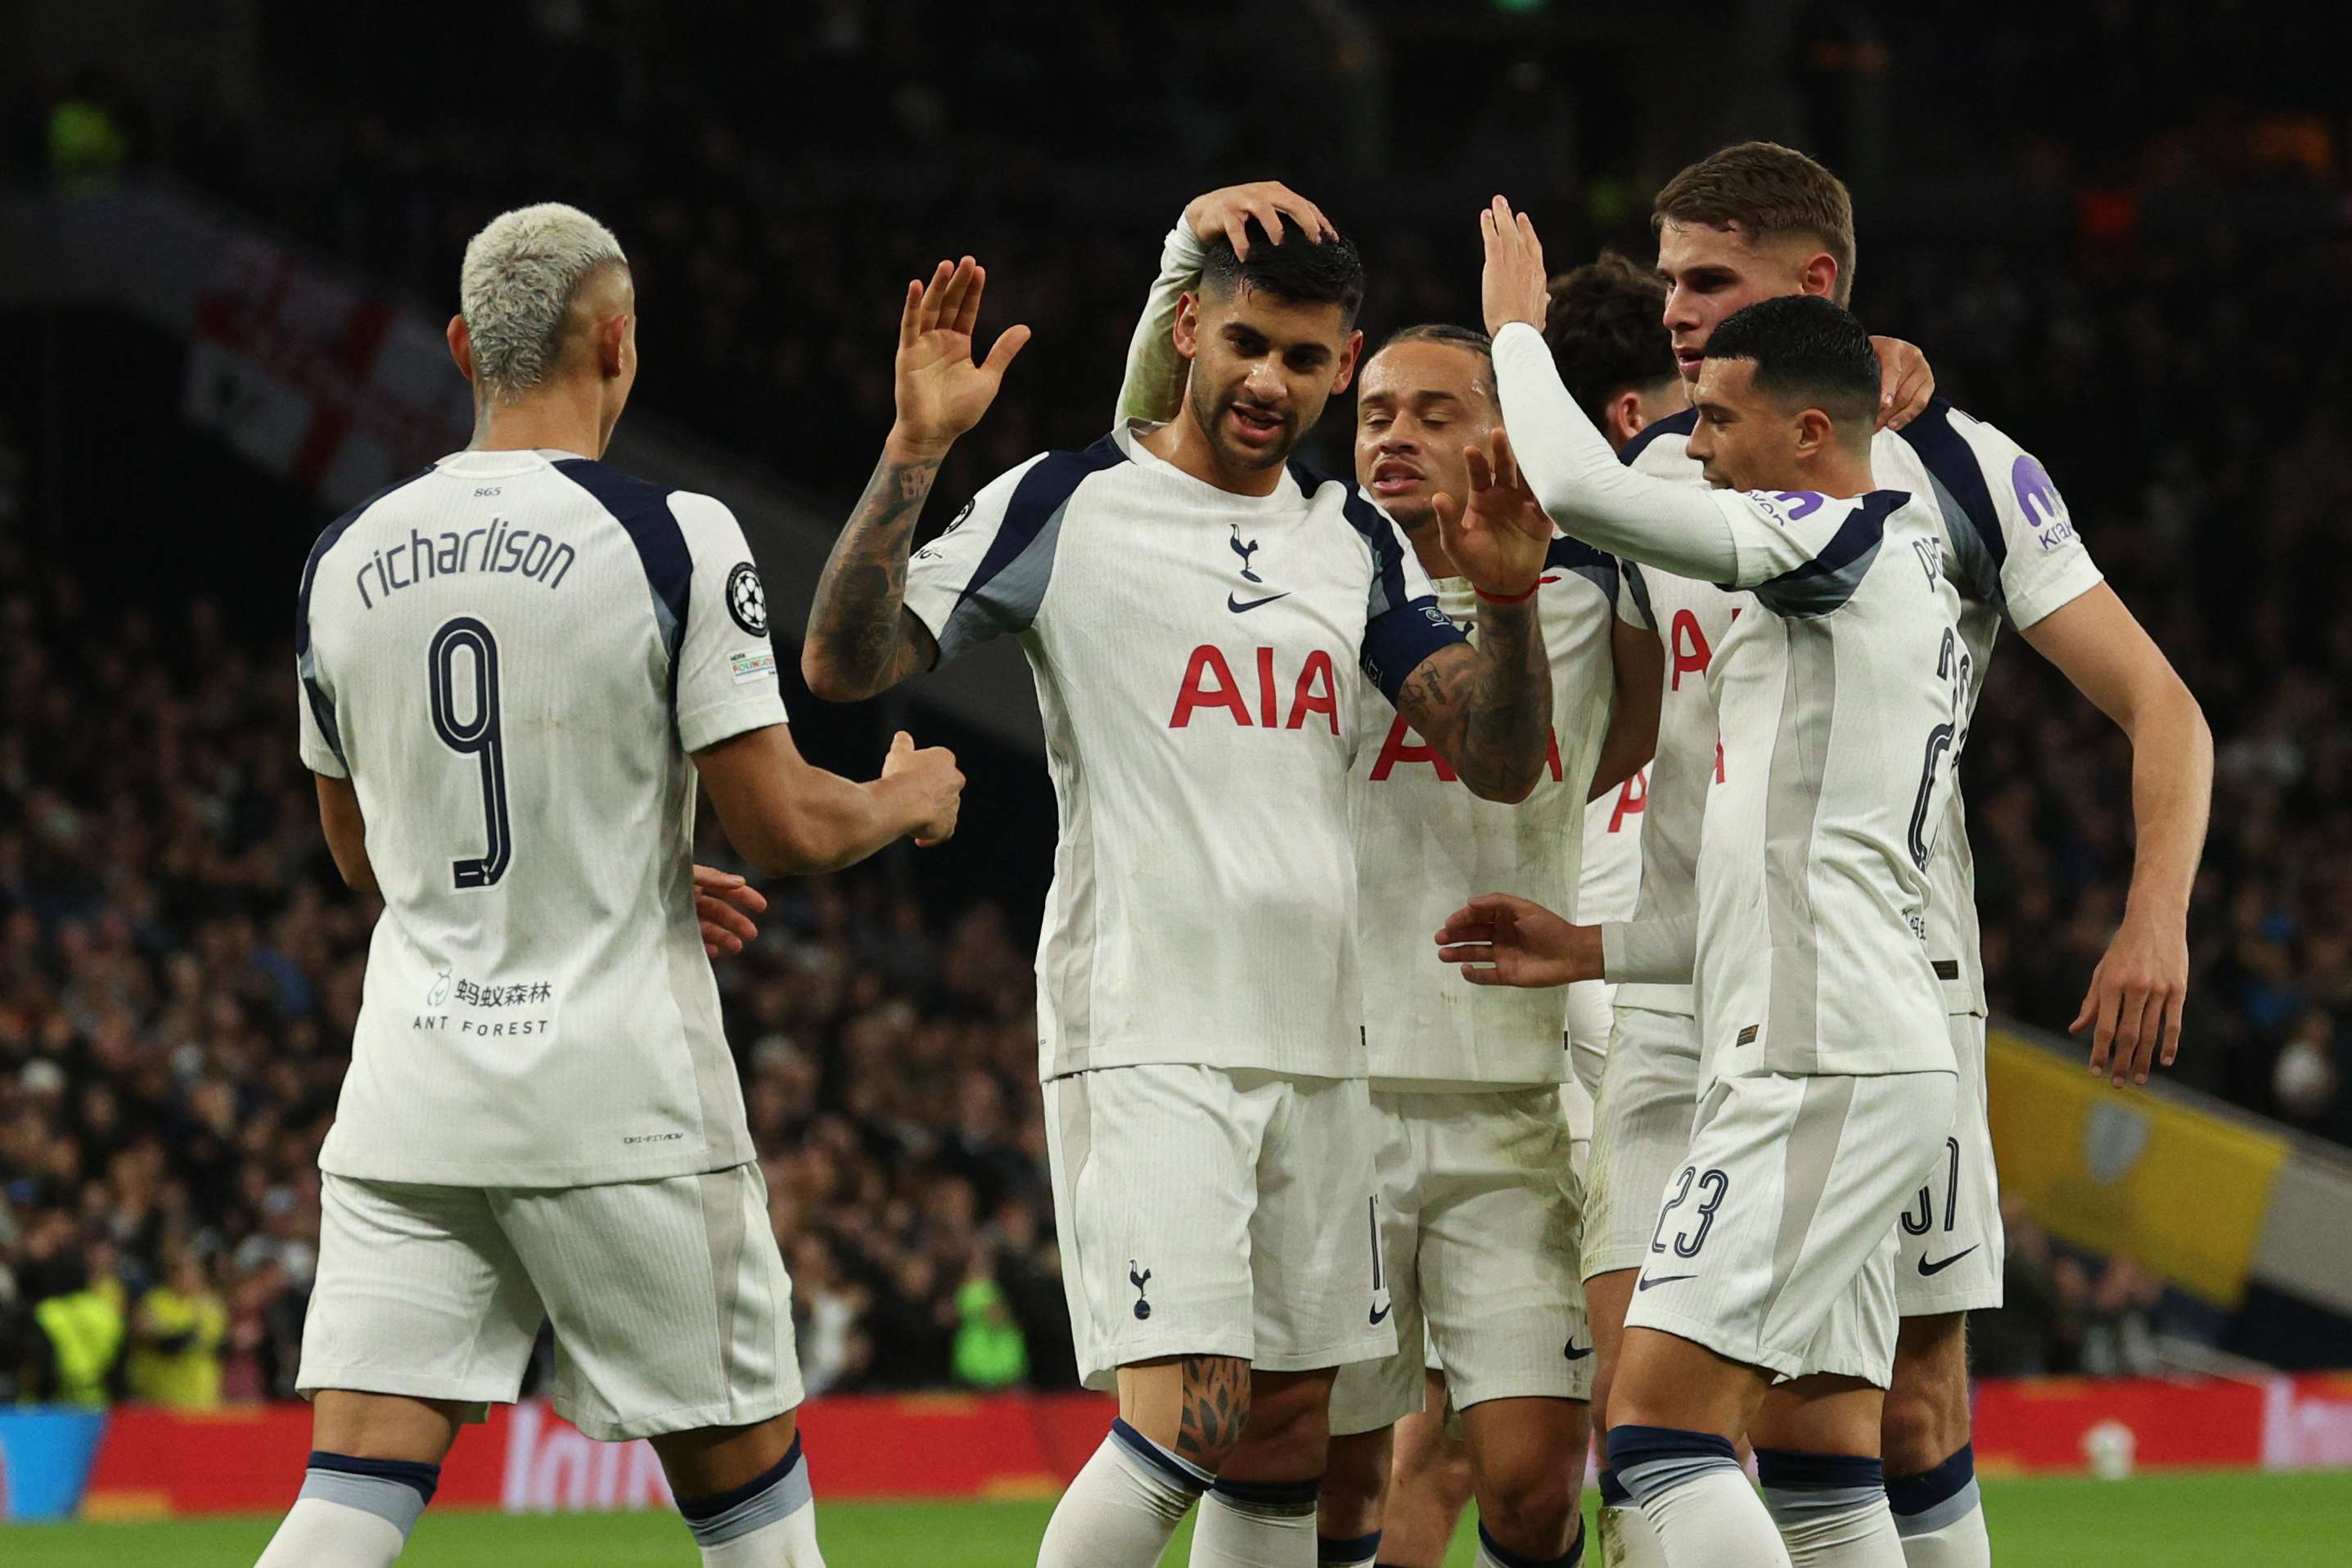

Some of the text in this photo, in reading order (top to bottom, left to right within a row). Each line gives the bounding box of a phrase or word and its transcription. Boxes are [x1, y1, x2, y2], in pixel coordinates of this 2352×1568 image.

[474, 486, 502, 497] 865
[356, 517, 575, 610] richarlison
[1169, 644, 1340, 736] AIA
[428, 616, 511, 889] 9
[412, 1016, 547, 1037] ANT FOREST
[454, 979, 552, 1007] 蚂蚁森林
[1651, 1165, 1729, 1259] 23
